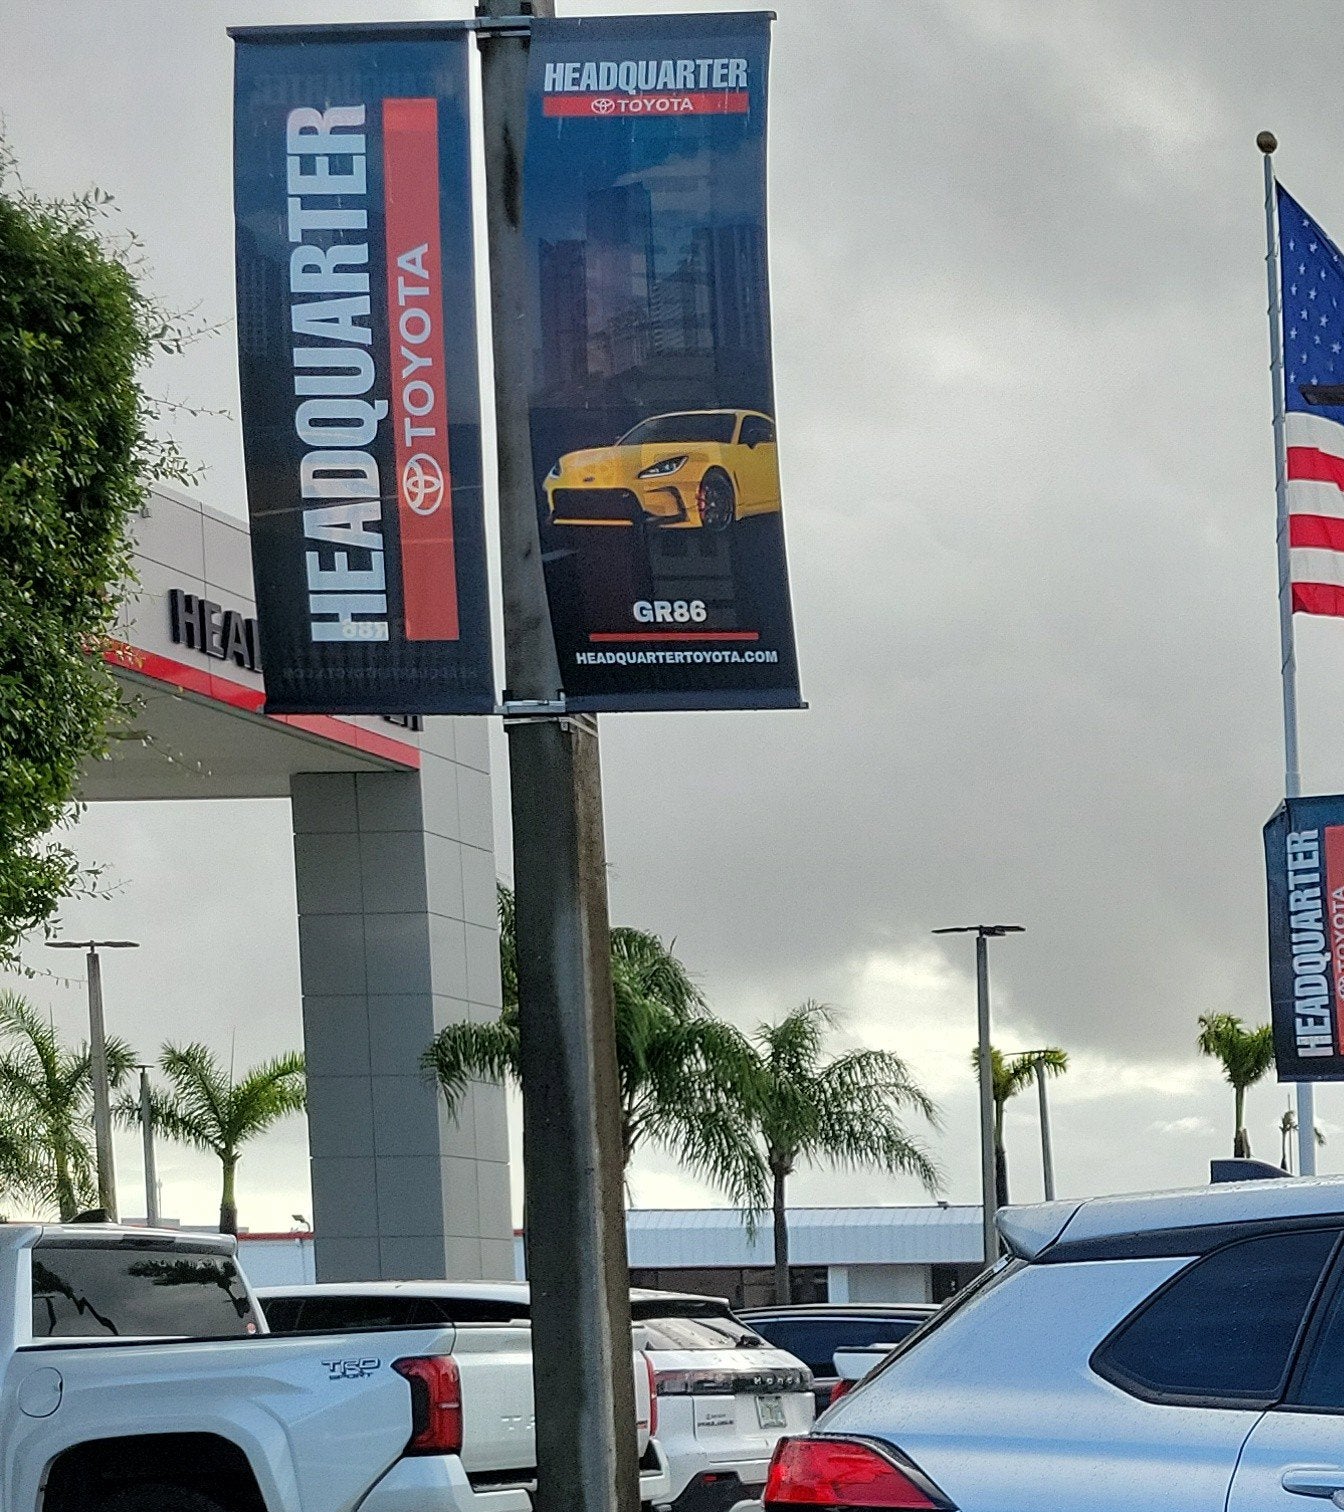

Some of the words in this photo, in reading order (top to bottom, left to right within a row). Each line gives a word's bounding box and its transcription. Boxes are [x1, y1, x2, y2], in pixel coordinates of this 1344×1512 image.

[544, 58, 748, 95] HEADQUARTER
[617, 98, 694, 112] TOYOTA
[397, 242, 436, 448] TOYOTA
[287, 103, 389, 642] HEADQUARTER
[633, 600, 707, 623] GR86
[576, 650, 779, 666] HEADQUARTERTOYOTA.COM
[1286, 828, 1334, 1058] HEADQUARTER
[320, 1357, 381, 1376] TRD
